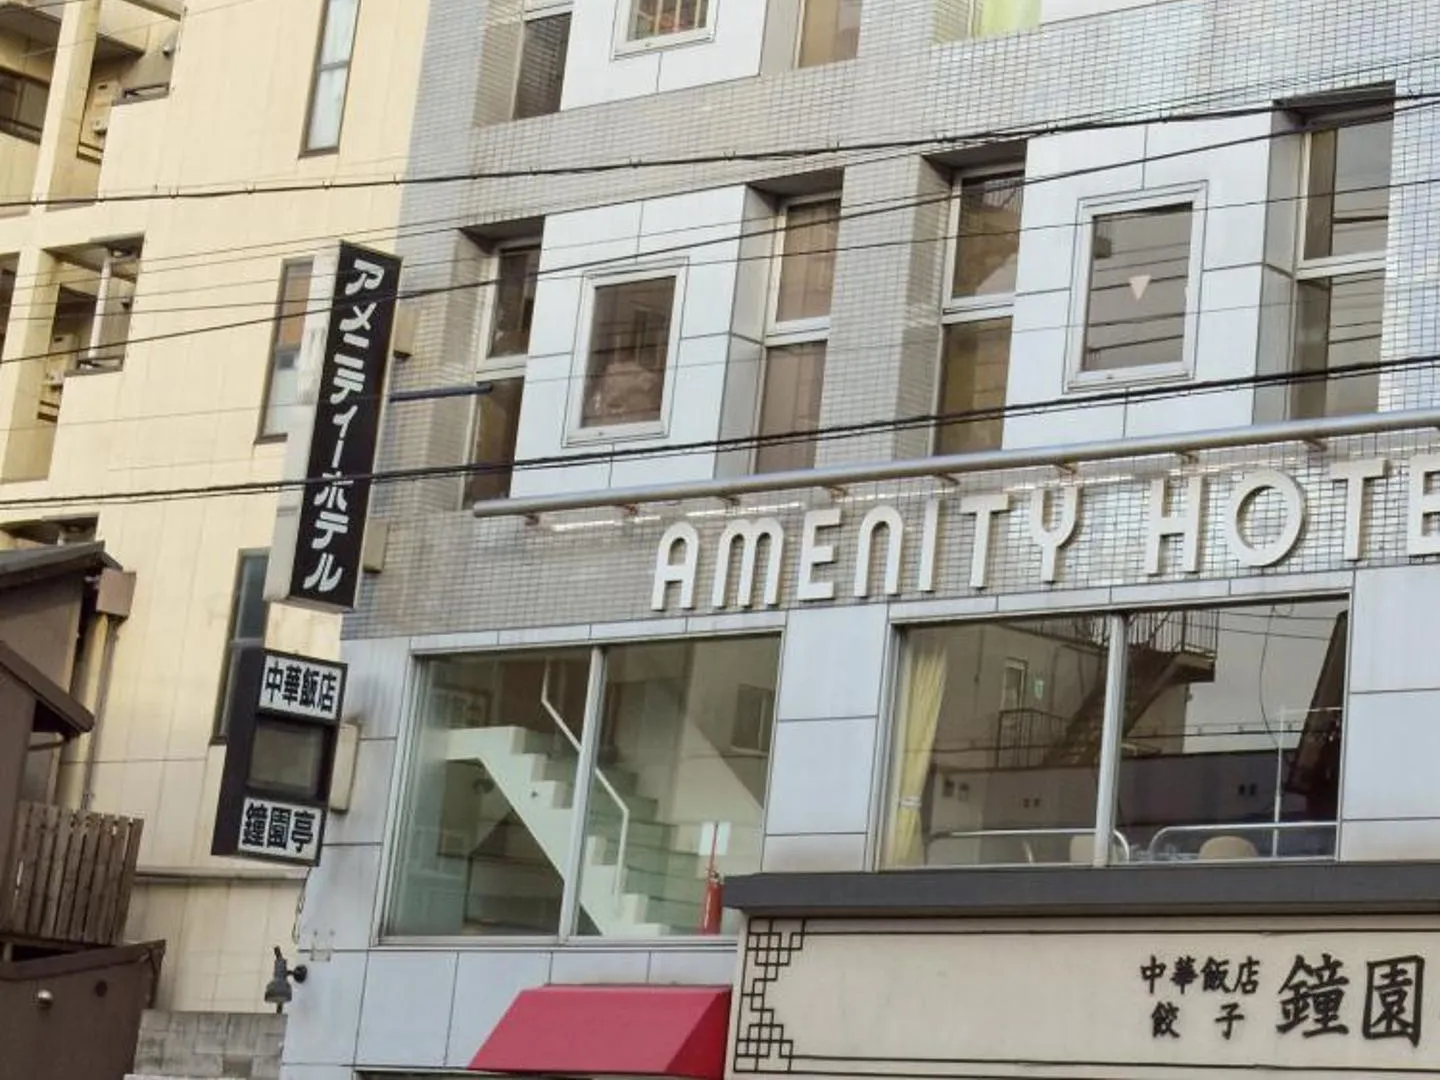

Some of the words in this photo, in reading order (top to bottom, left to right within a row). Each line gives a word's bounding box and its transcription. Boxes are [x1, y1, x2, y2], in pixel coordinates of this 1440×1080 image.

[303, 258, 384, 593] アメニティーホテル
[651, 484, 1079, 611] AMENITY
[264, 660, 337, 713] 中華飯店
[1140, 954, 1261, 995] 中華飯店
[1151, 1001, 1246, 1040] 餃子
